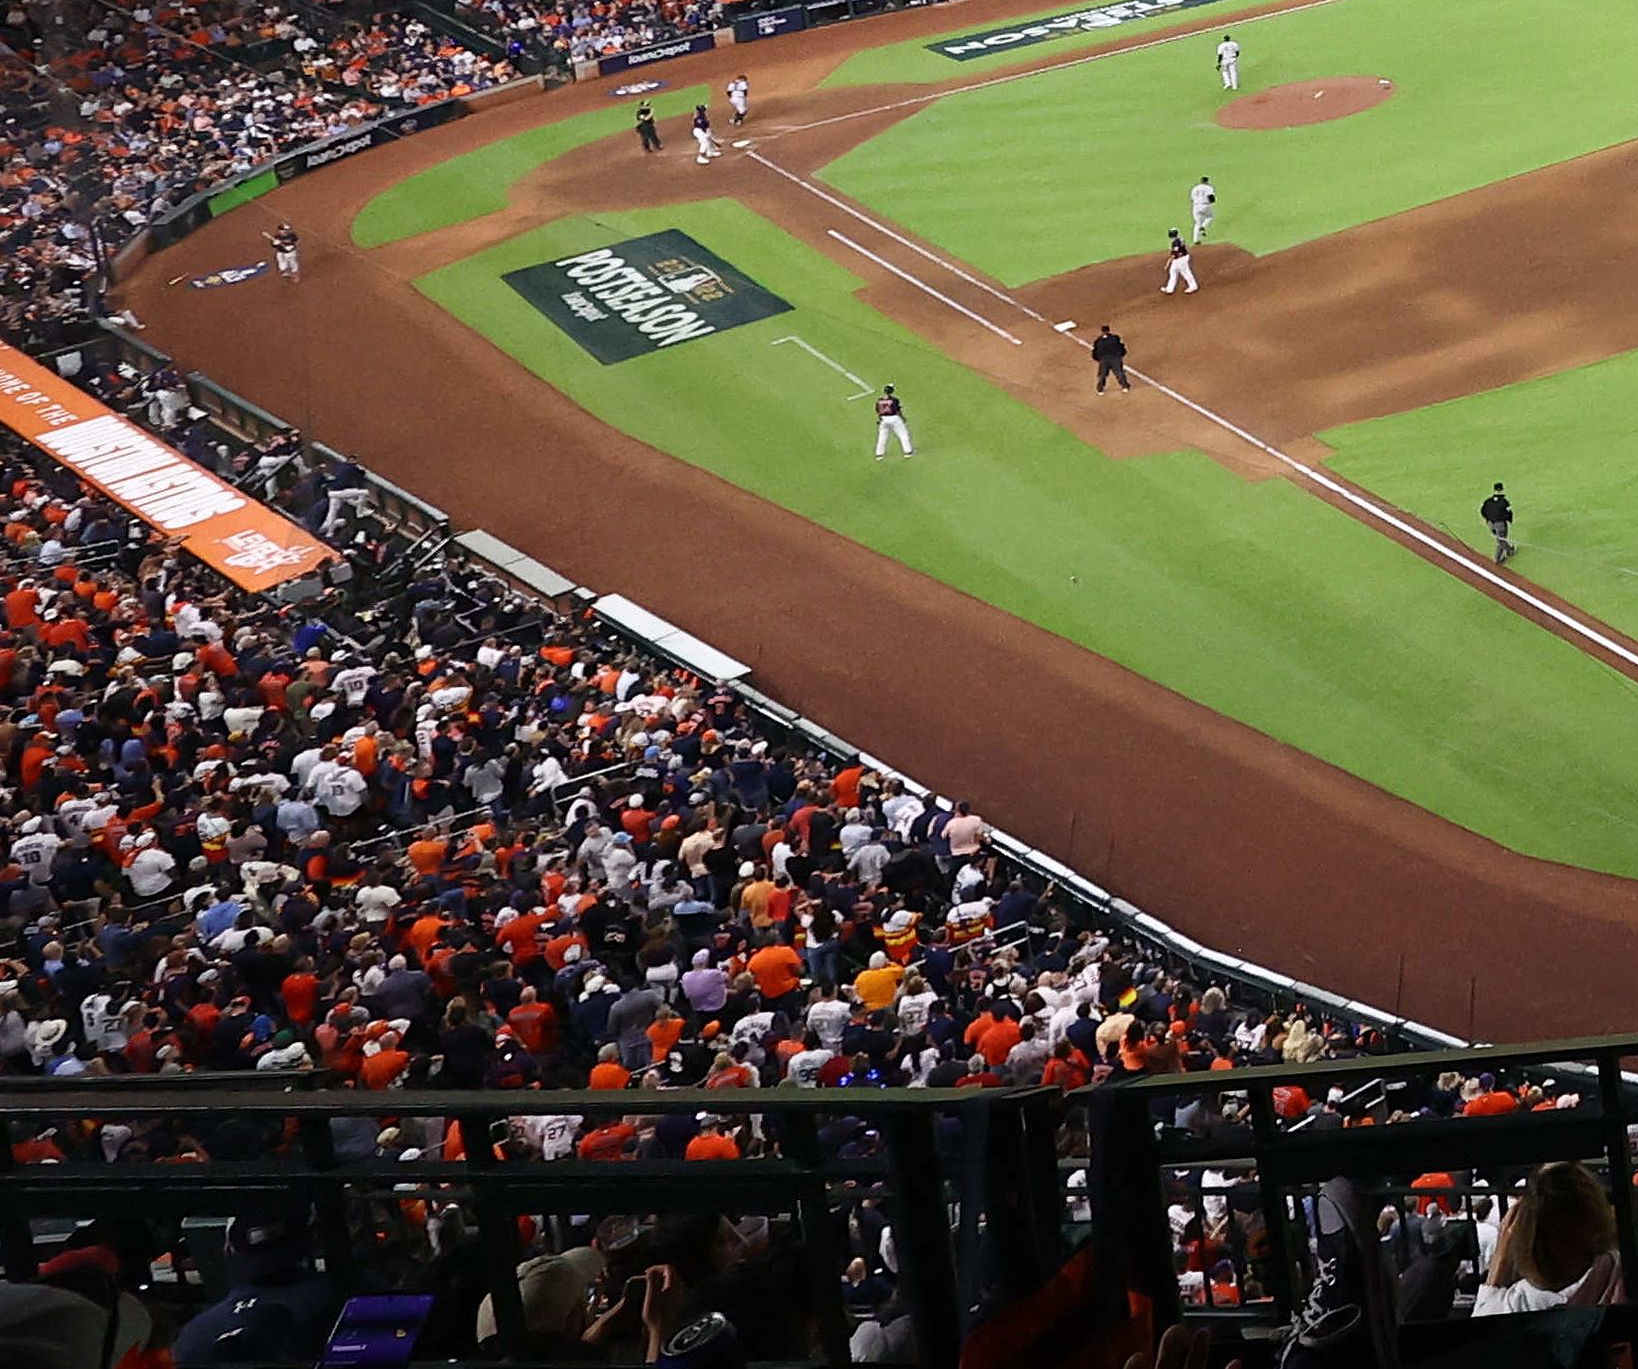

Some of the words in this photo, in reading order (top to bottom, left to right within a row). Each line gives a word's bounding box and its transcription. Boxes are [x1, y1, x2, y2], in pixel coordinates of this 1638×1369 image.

[628, 41, 690, 66] loanDepot
[306, 135, 374, 169] loanDepot
[555, 248, 716, 347] POSTSEASON
[34, 404, 79, 426] THE
[547, 1125, 566, 1140] 27
